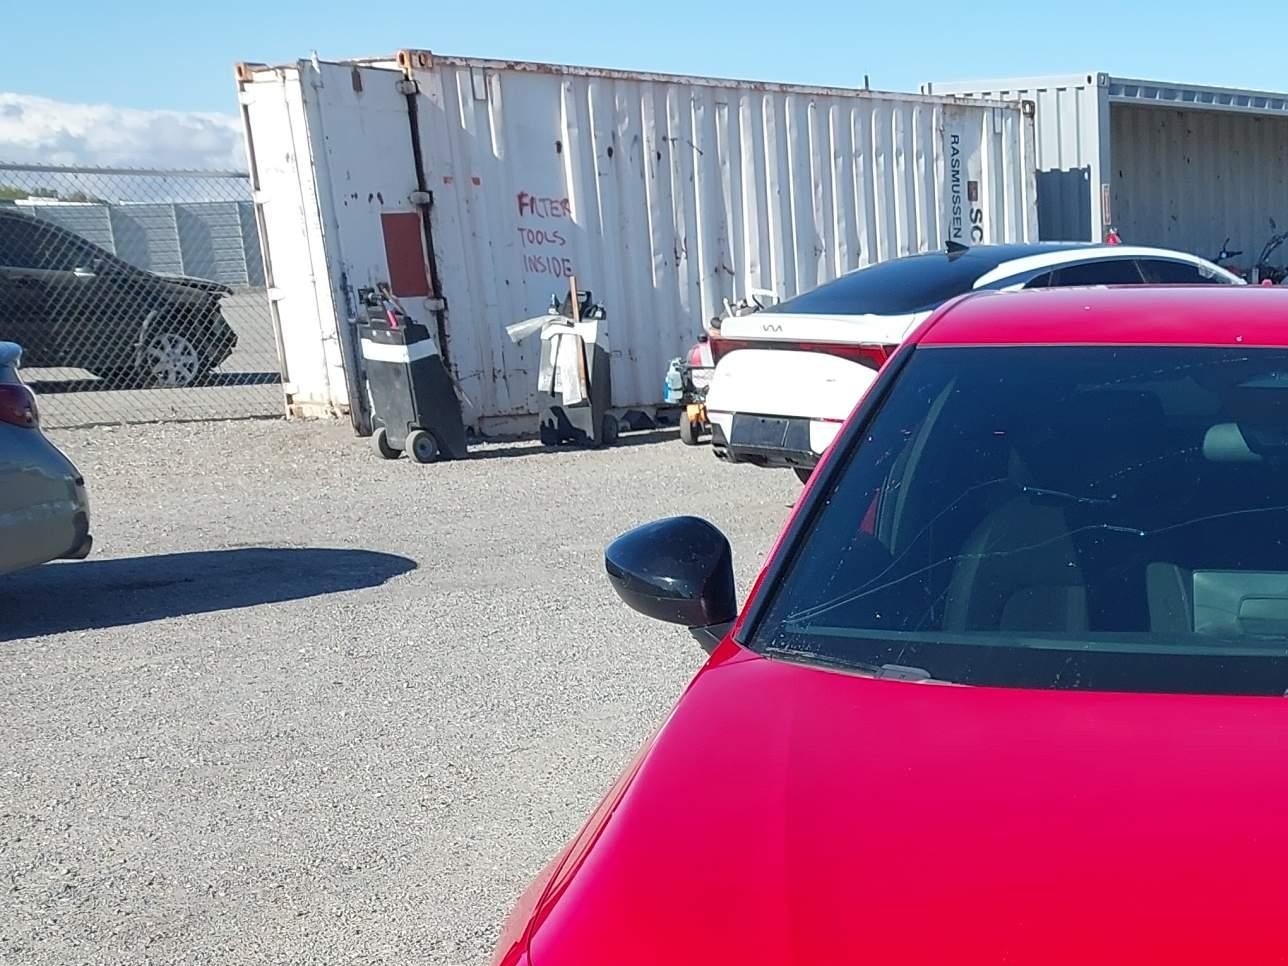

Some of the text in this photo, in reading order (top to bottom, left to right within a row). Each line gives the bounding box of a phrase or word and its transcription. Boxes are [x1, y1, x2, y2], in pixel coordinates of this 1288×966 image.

[950, 134, 962, 239] RASMUSSEN
[517, 191, 572, 218] FILTER
[517, 227, 566, 248] TOOLS
[523, 254, 574, 278] INSIDE
